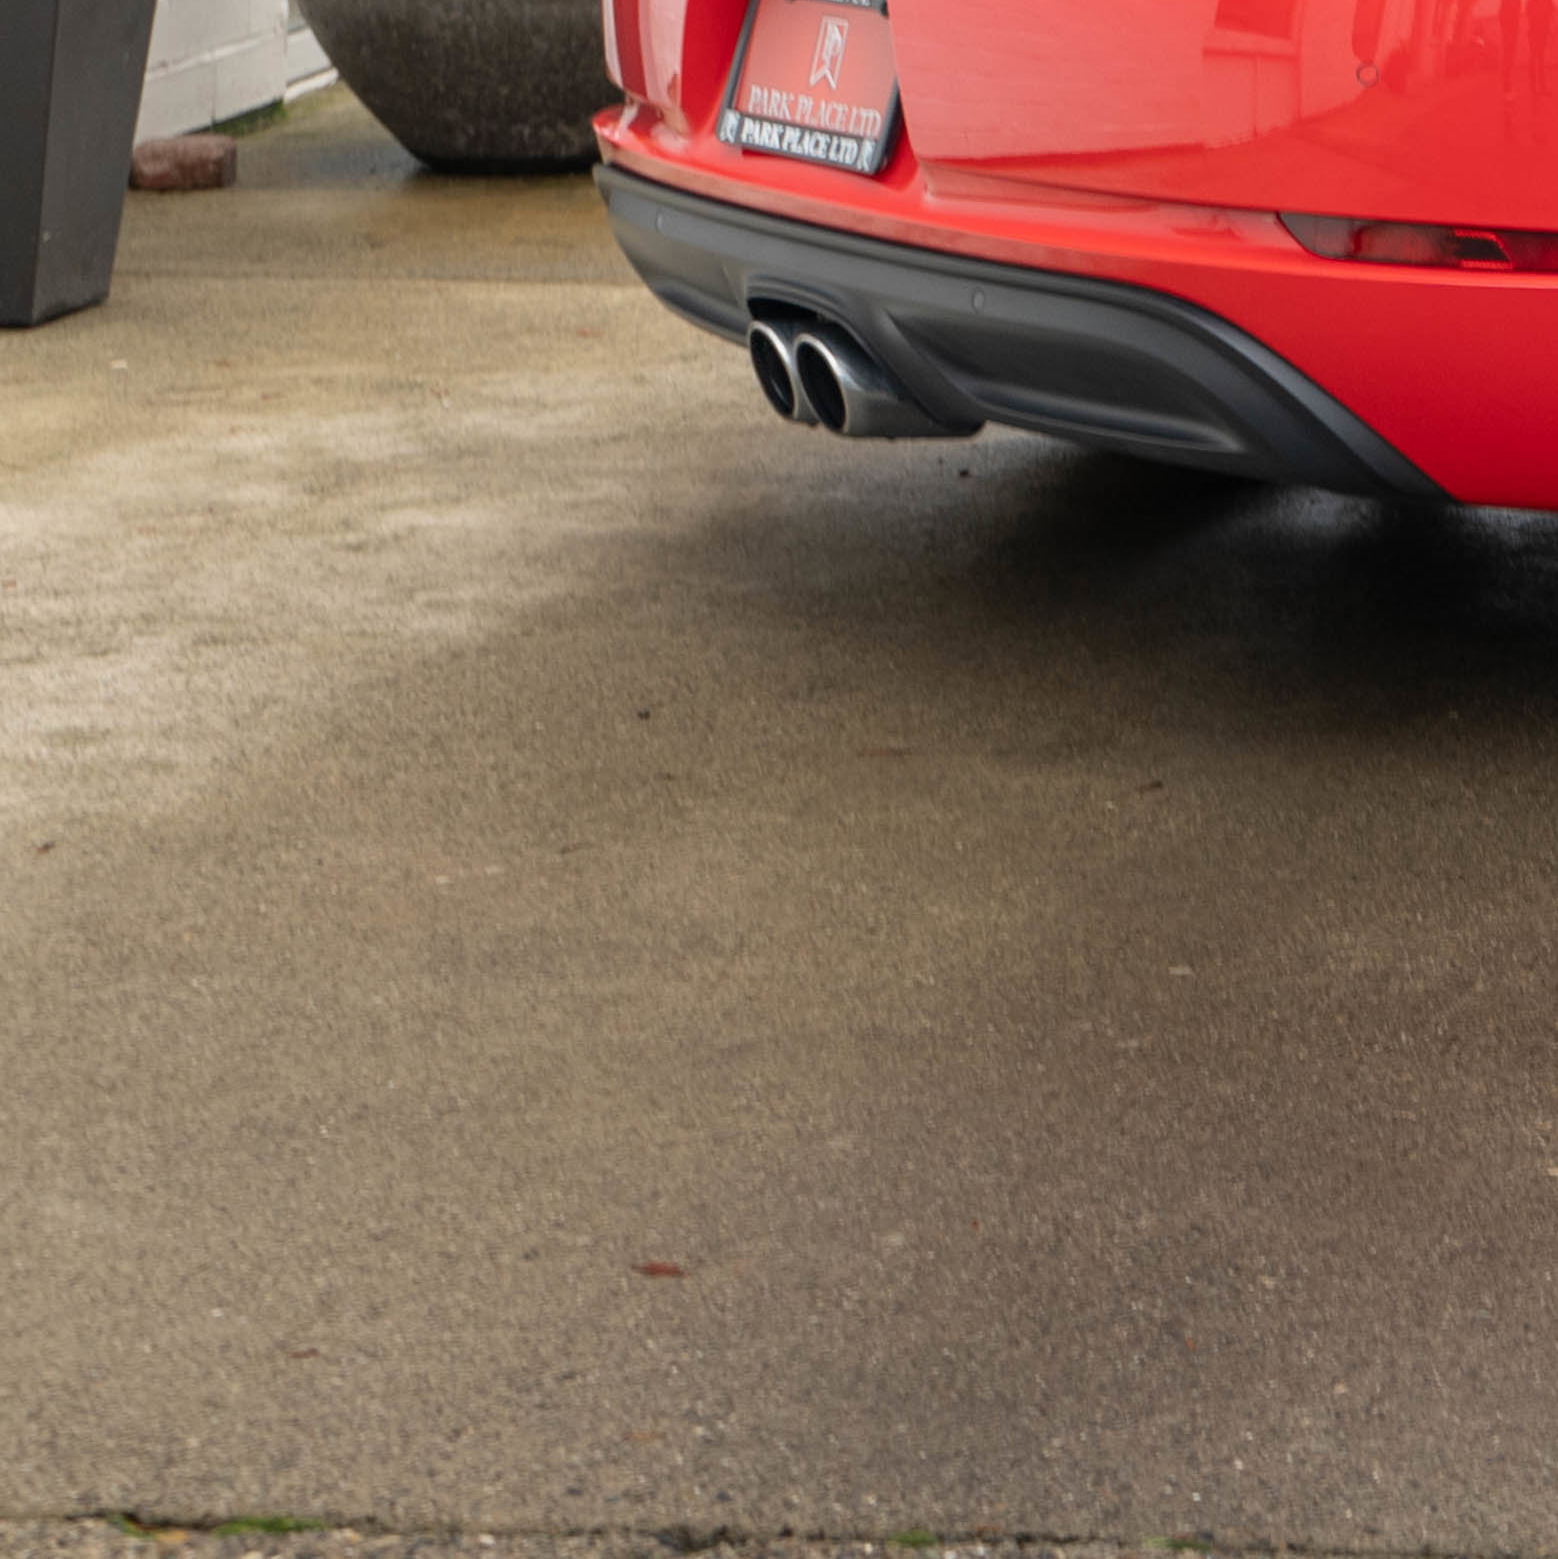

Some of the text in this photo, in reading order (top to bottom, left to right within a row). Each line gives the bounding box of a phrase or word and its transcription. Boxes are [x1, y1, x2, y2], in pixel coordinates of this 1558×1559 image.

[748, 84, 882, 140] PARK PLACE LTD
[739, 116, 859, 166] PARK PLACE LTD
